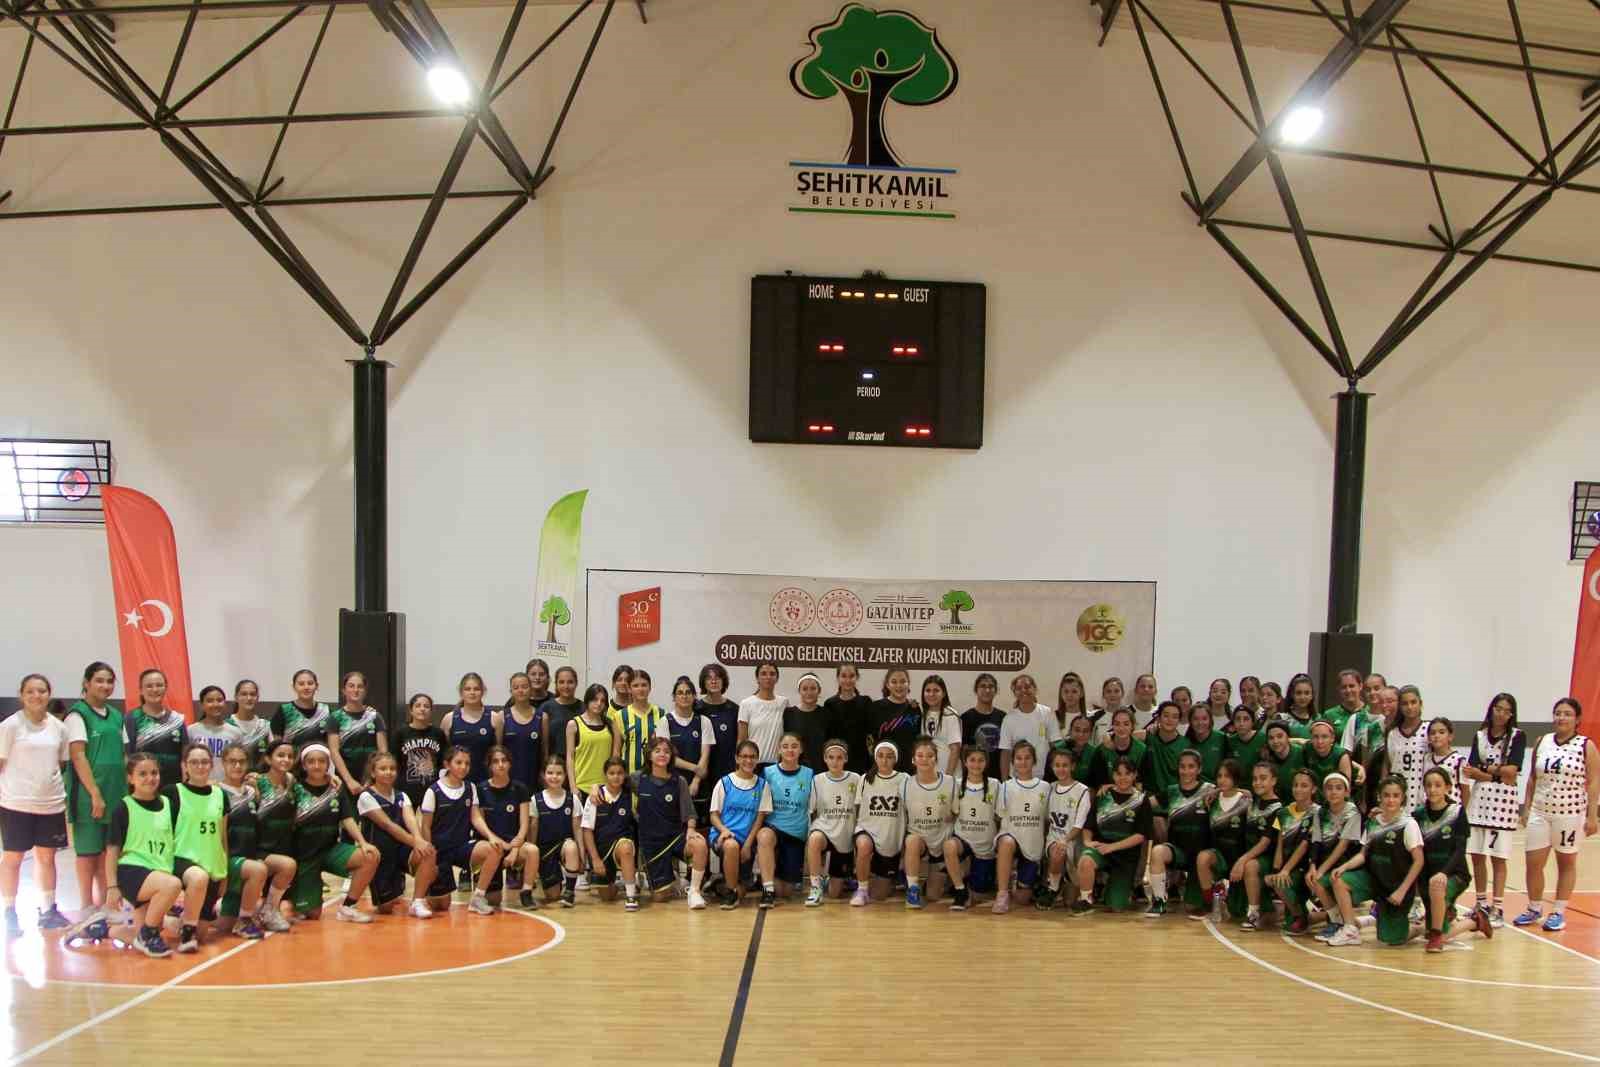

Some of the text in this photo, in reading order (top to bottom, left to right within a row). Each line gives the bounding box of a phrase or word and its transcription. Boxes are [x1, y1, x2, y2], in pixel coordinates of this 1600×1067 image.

[809, 284, 834, 300] HOME
[903, 288, 930, 303] GUEST
[856, 387, 881, 398] PERIOD
[629, 601, 649, 616] 30
[867, 604, 935, 620] GAZİANTEP
[721, 642, 1026, 665] 30 AĞUSTOS GELENEKSEL ZAFER KUPASI ETKİNLİKLERİ
[1402, 754, 1412, 771] 9
[1544, 758, 1561, 774] 14
[784, 788, 791, 797] 5
[836, 796, 842, 805] 2
[1024, 802, 1030, 812] 2
[970, 808, 976, 817] 3
[200, 821, 216, 835] 53
[1488, 830, 1499, 848] 7
[1559, 830, 1576, 847] 14
